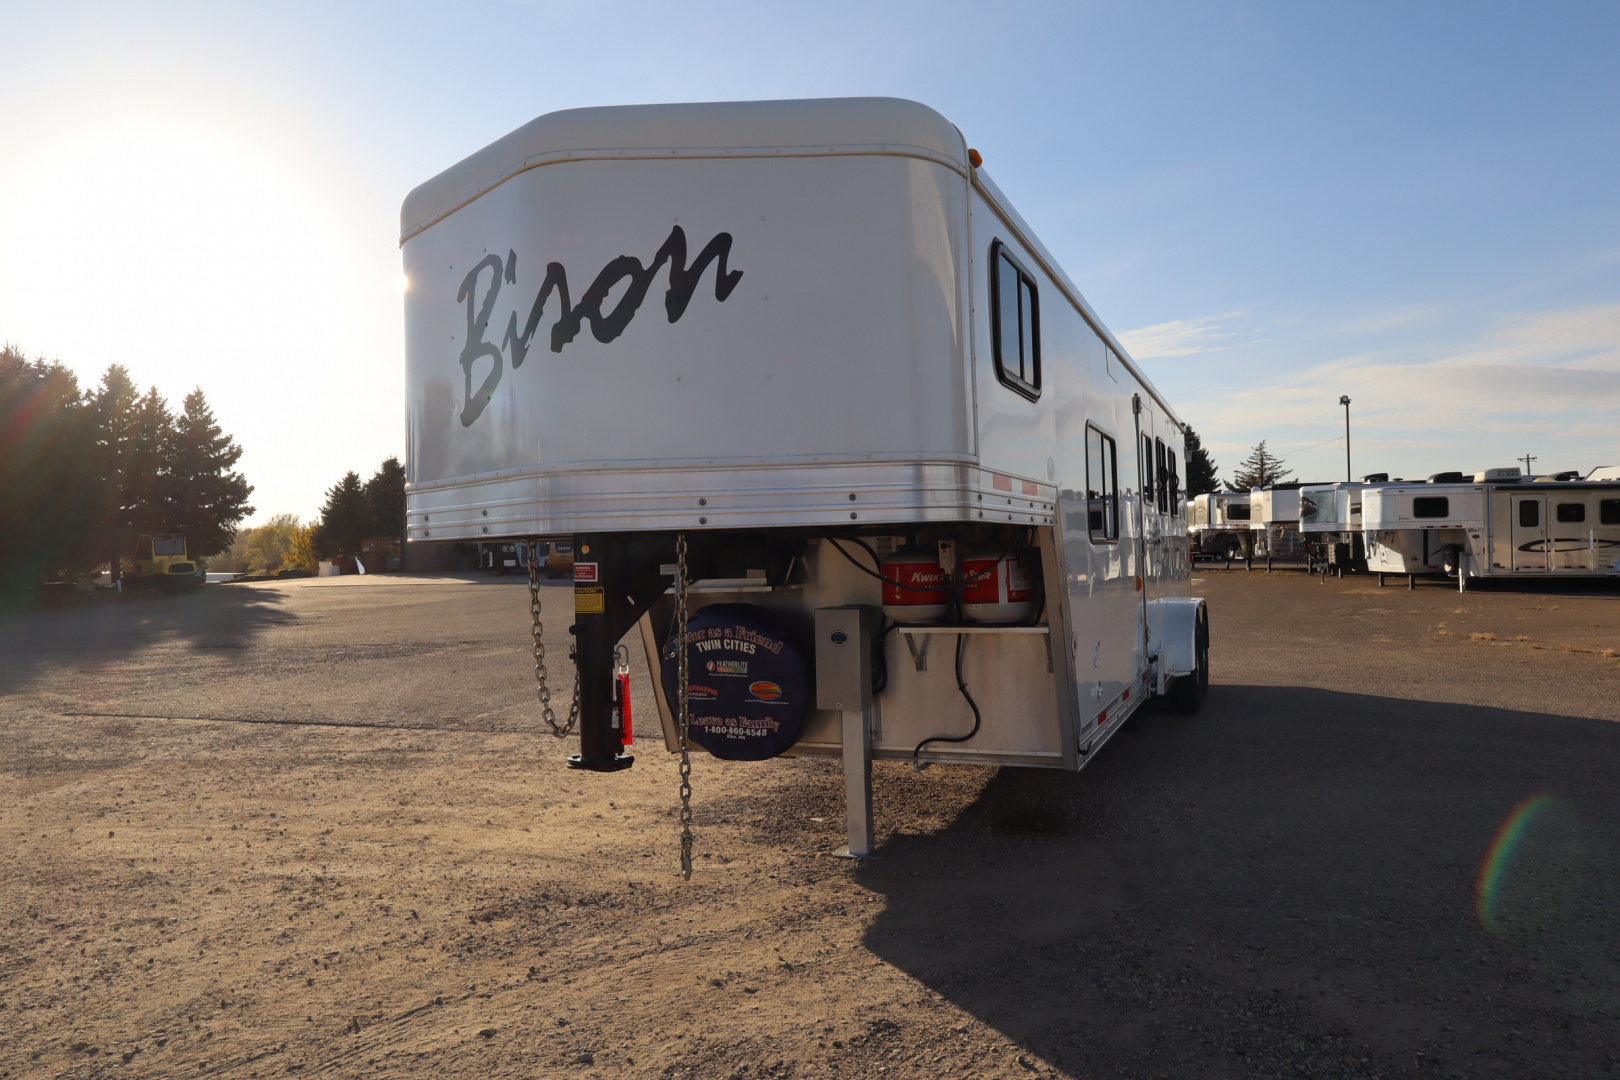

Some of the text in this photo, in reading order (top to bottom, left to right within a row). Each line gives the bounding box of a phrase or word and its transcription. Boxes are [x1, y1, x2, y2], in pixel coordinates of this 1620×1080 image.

[457, 225, 744, 428] Bison
[695, 638, 757, 655] TWIN CITIES
[708, 627, 722, 638] as
[725, 627, 732, 638] a
[736, 625, 784, 655] Friend
[690, 713, 780, 733] Leave as Family
